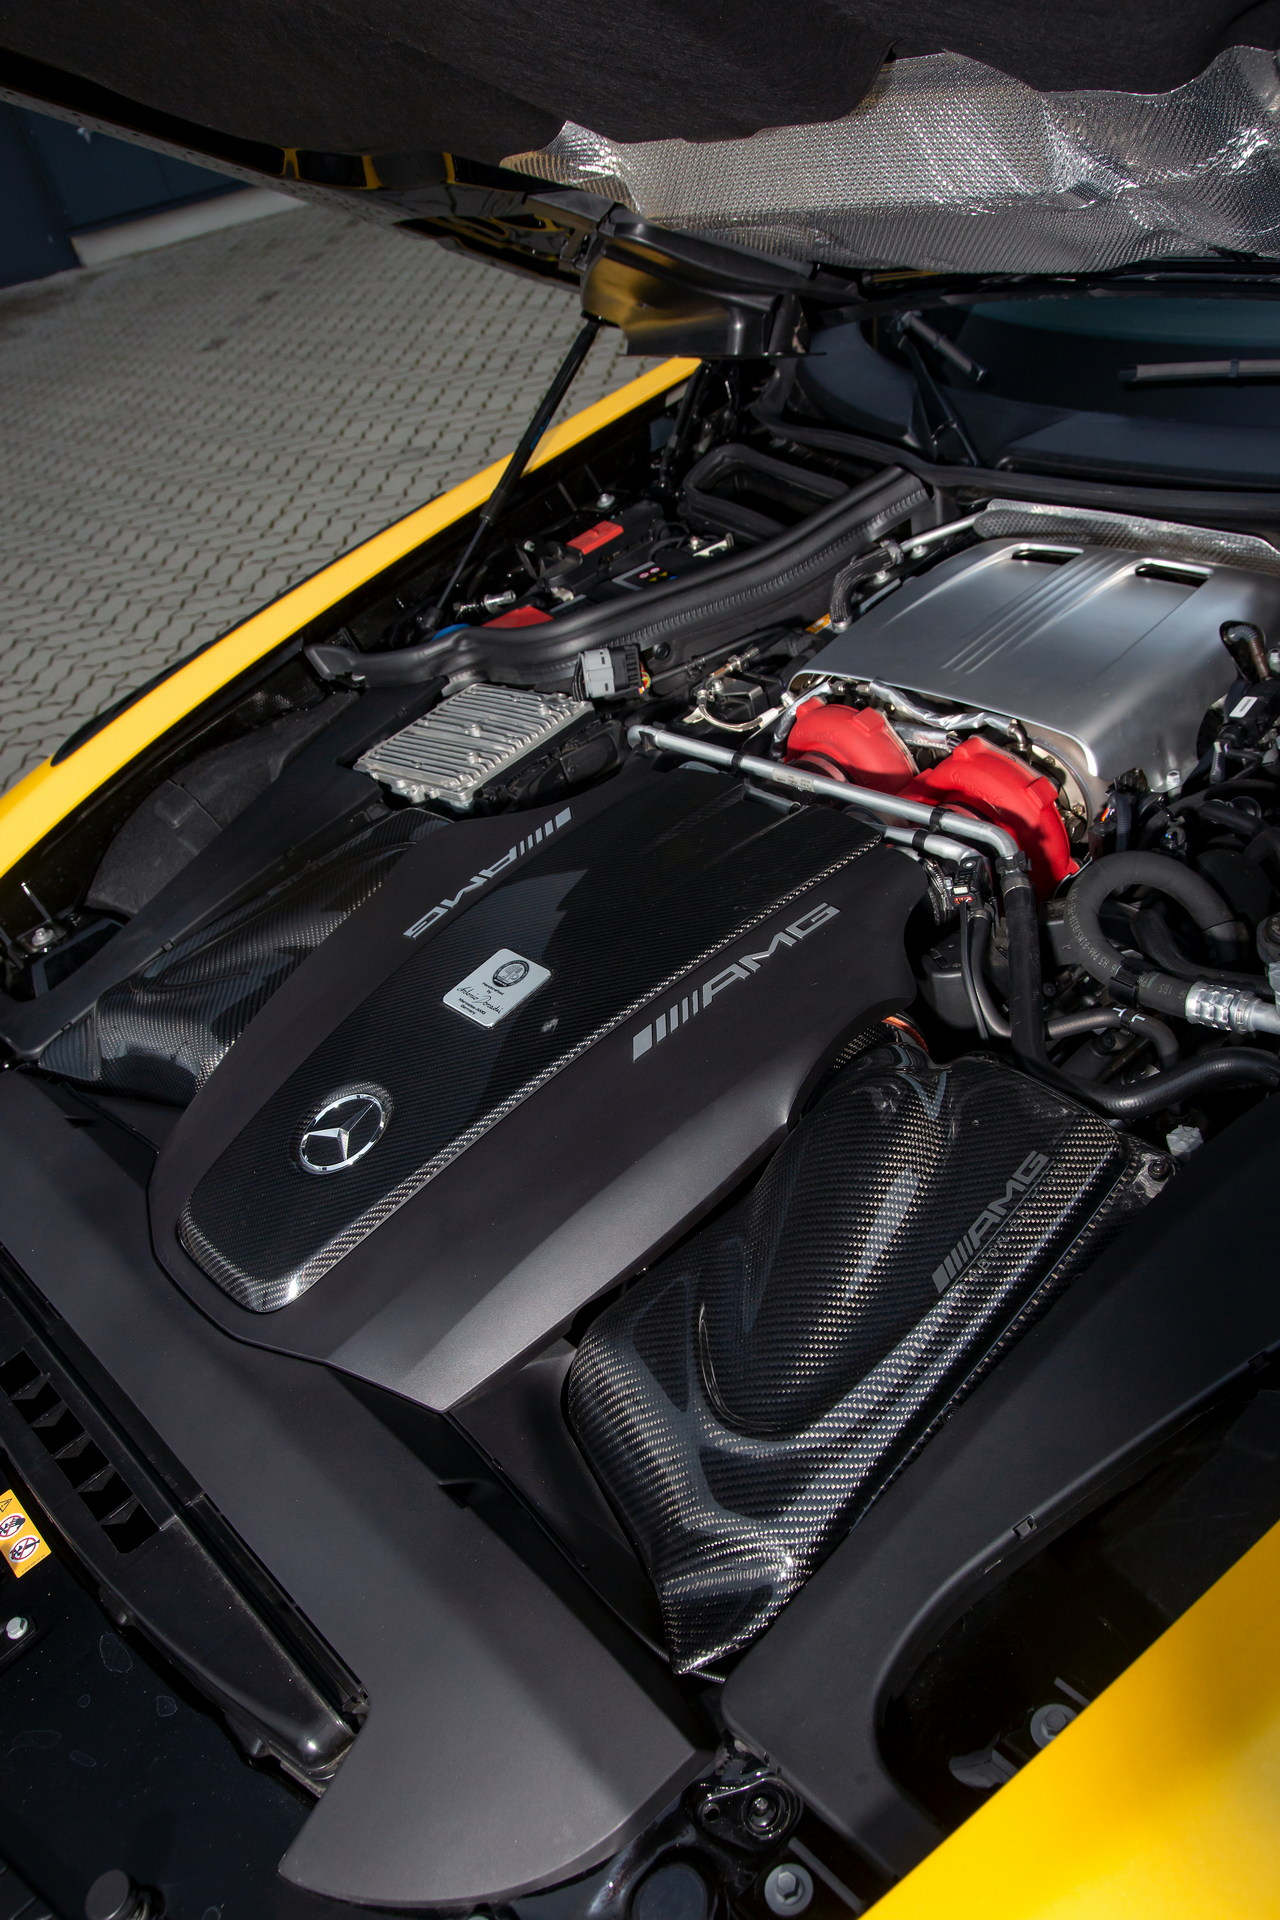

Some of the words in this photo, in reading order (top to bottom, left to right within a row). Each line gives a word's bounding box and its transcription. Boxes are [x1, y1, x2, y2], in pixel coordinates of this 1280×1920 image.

[403, 845, 518, 940] AMG
[702, 902, 841, 1009] AMG
[968, 1150, 1050, 1250] AMG
[949, 1234, 1010, 1307] CARBON
